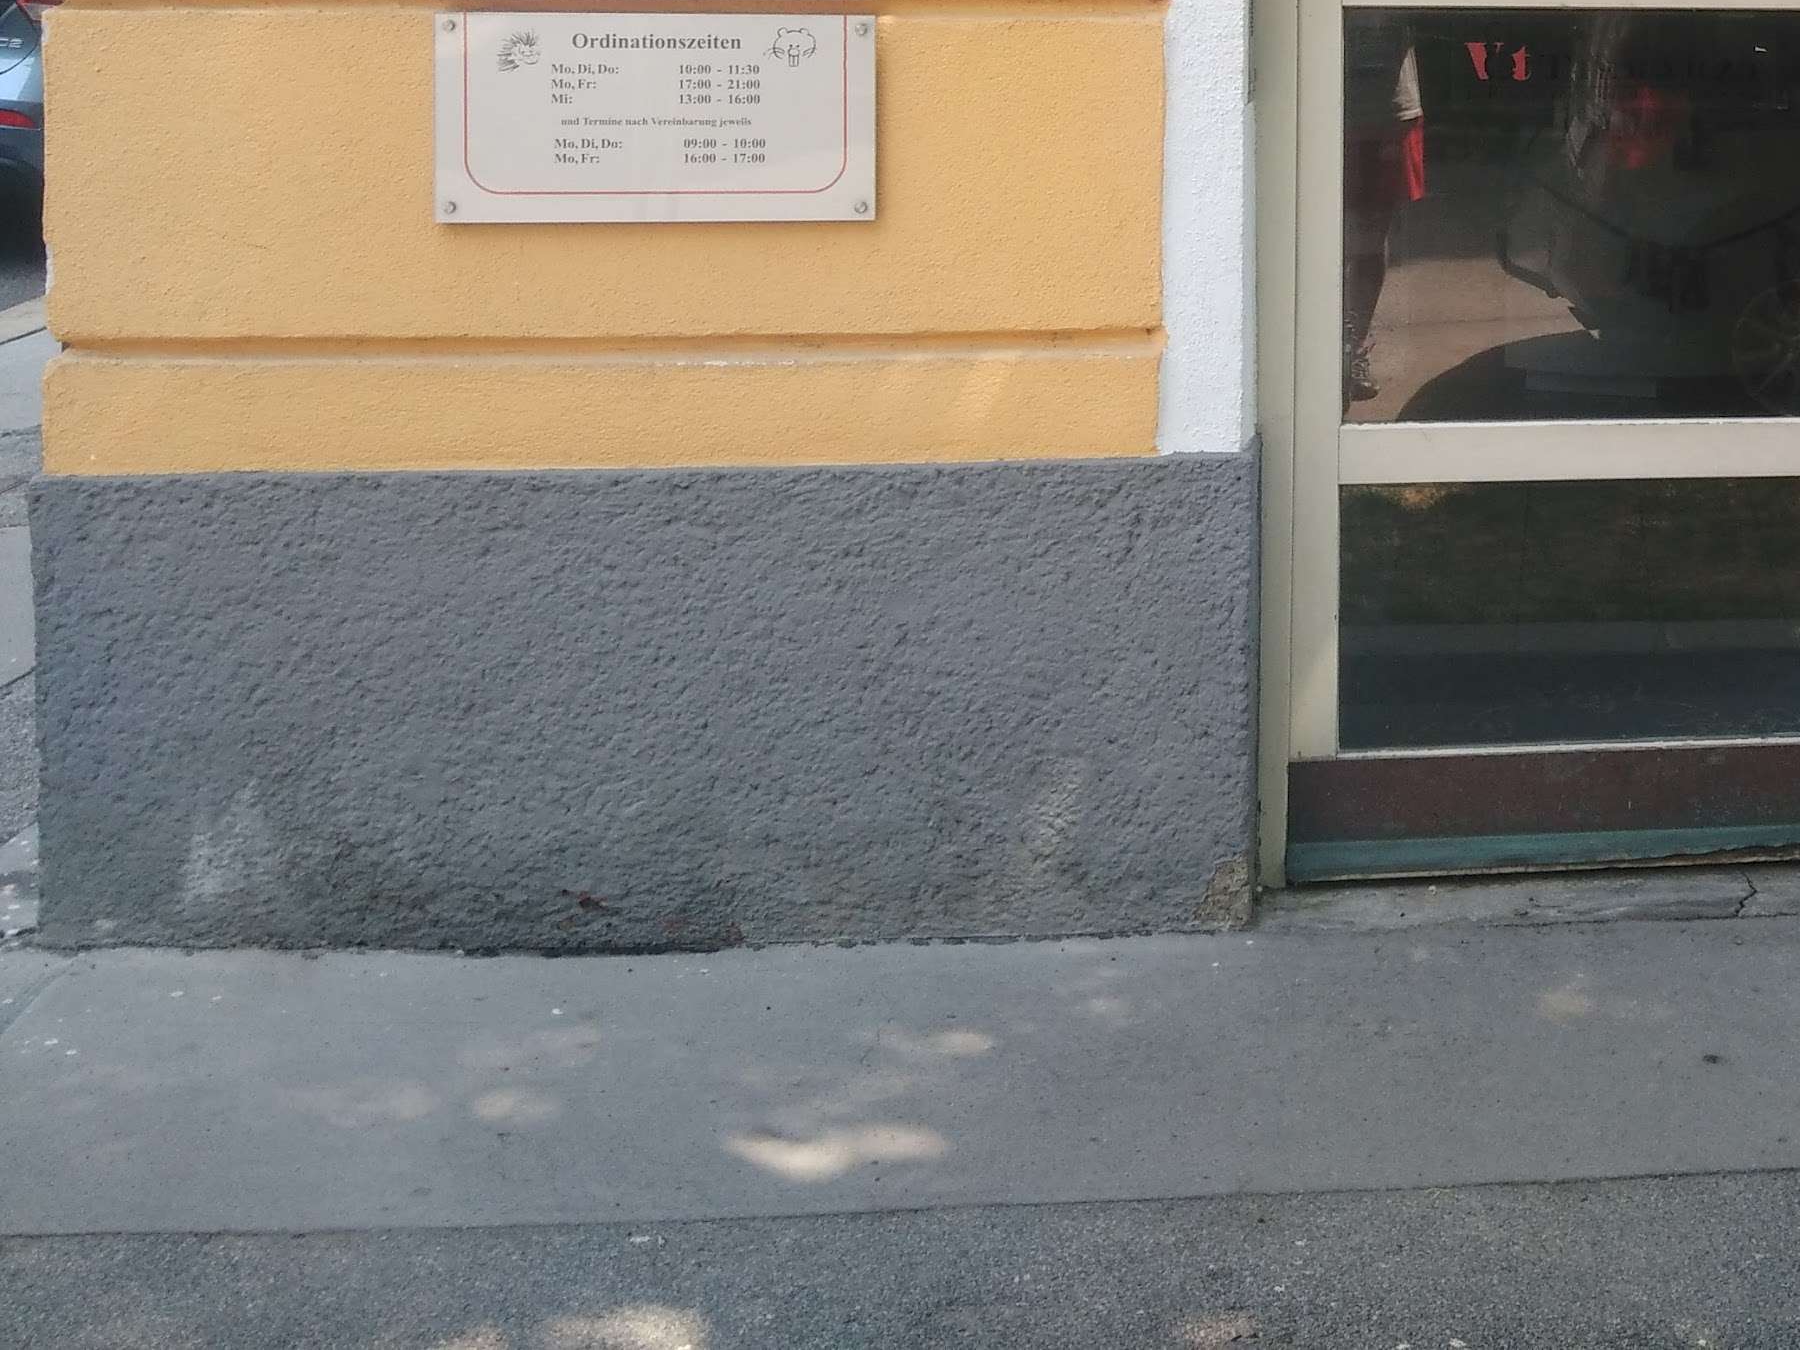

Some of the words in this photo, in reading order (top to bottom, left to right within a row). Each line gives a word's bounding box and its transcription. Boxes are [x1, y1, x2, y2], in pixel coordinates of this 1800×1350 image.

[571, 33, 742, 50] Ordinationszeiten
[678, 65, 711, 75] 10:00
[727, 65, 760, 75] 11:30
[678, 79, 711, 89] 17:00
[727, 79, 760, 89] 21:00
[551, 93, 573, 104] Mi:
[678, 94, 711, 104] 13:00
[727, 94, 760, 104] 16:00
[561, 117, 580, 126] und
[583, 117, 622, 126] Termine
[625, 117, 648, 126] nach
[651, 117, 717, 128] Vereinbarung
[719, 117, 752, 128] jeweils
[683, 138, 717, 149] 09:00
[733, 138, 766, 149] 10:00
[683, 153, 717, 164] 16:00
[733, 153, 766, 164] 17:00
